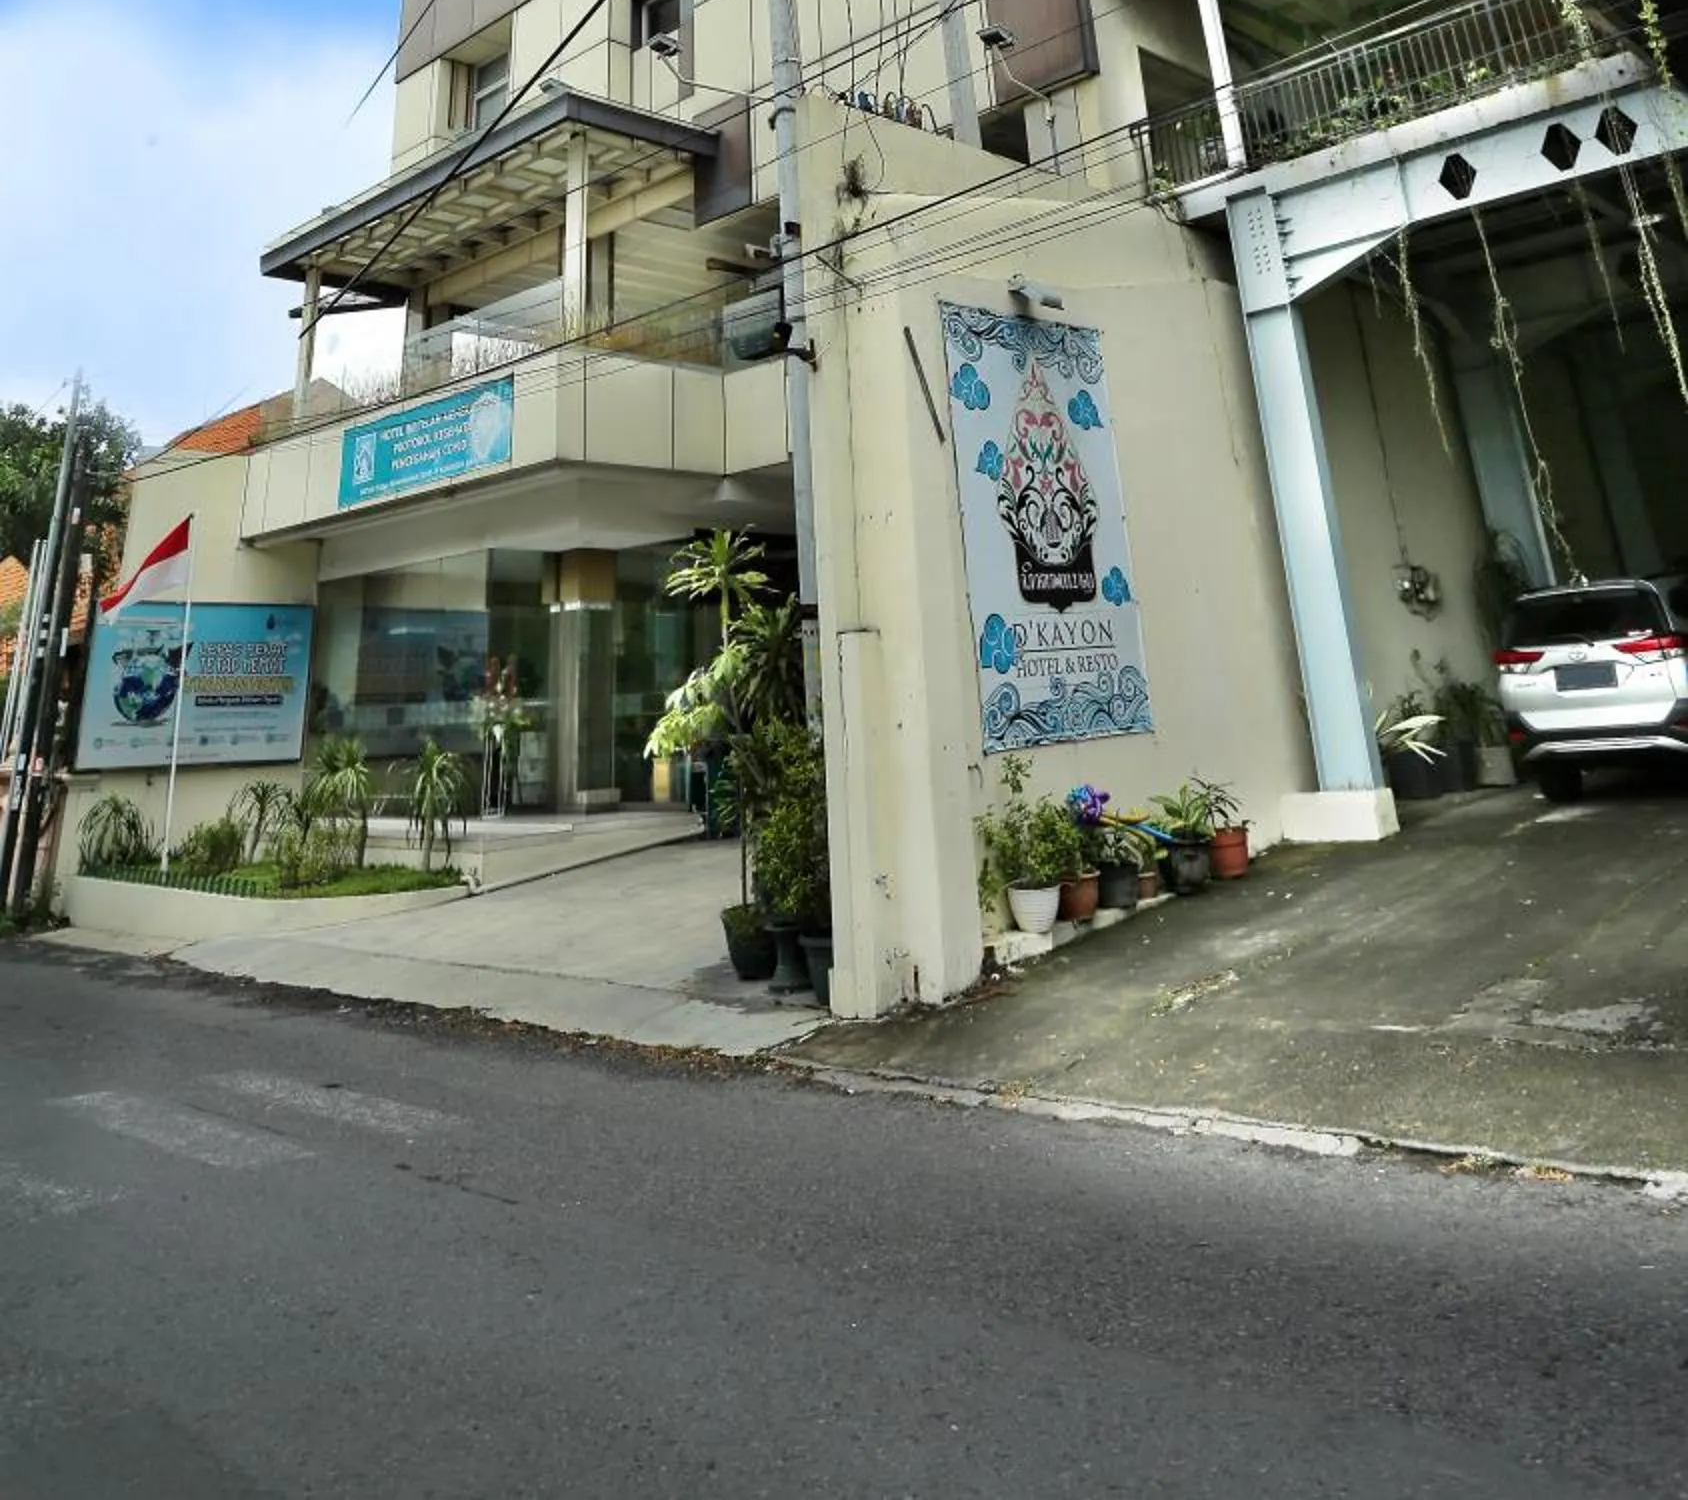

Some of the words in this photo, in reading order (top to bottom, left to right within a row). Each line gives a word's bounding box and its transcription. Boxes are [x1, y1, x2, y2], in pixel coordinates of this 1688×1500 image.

[1012, 619, 1113, 648] D'KAYON
[1016, 657, 1062, 678] HOTEL
[1065, 658, 1076, 675] &
[1078, 653, 1118, 673] RESTO
